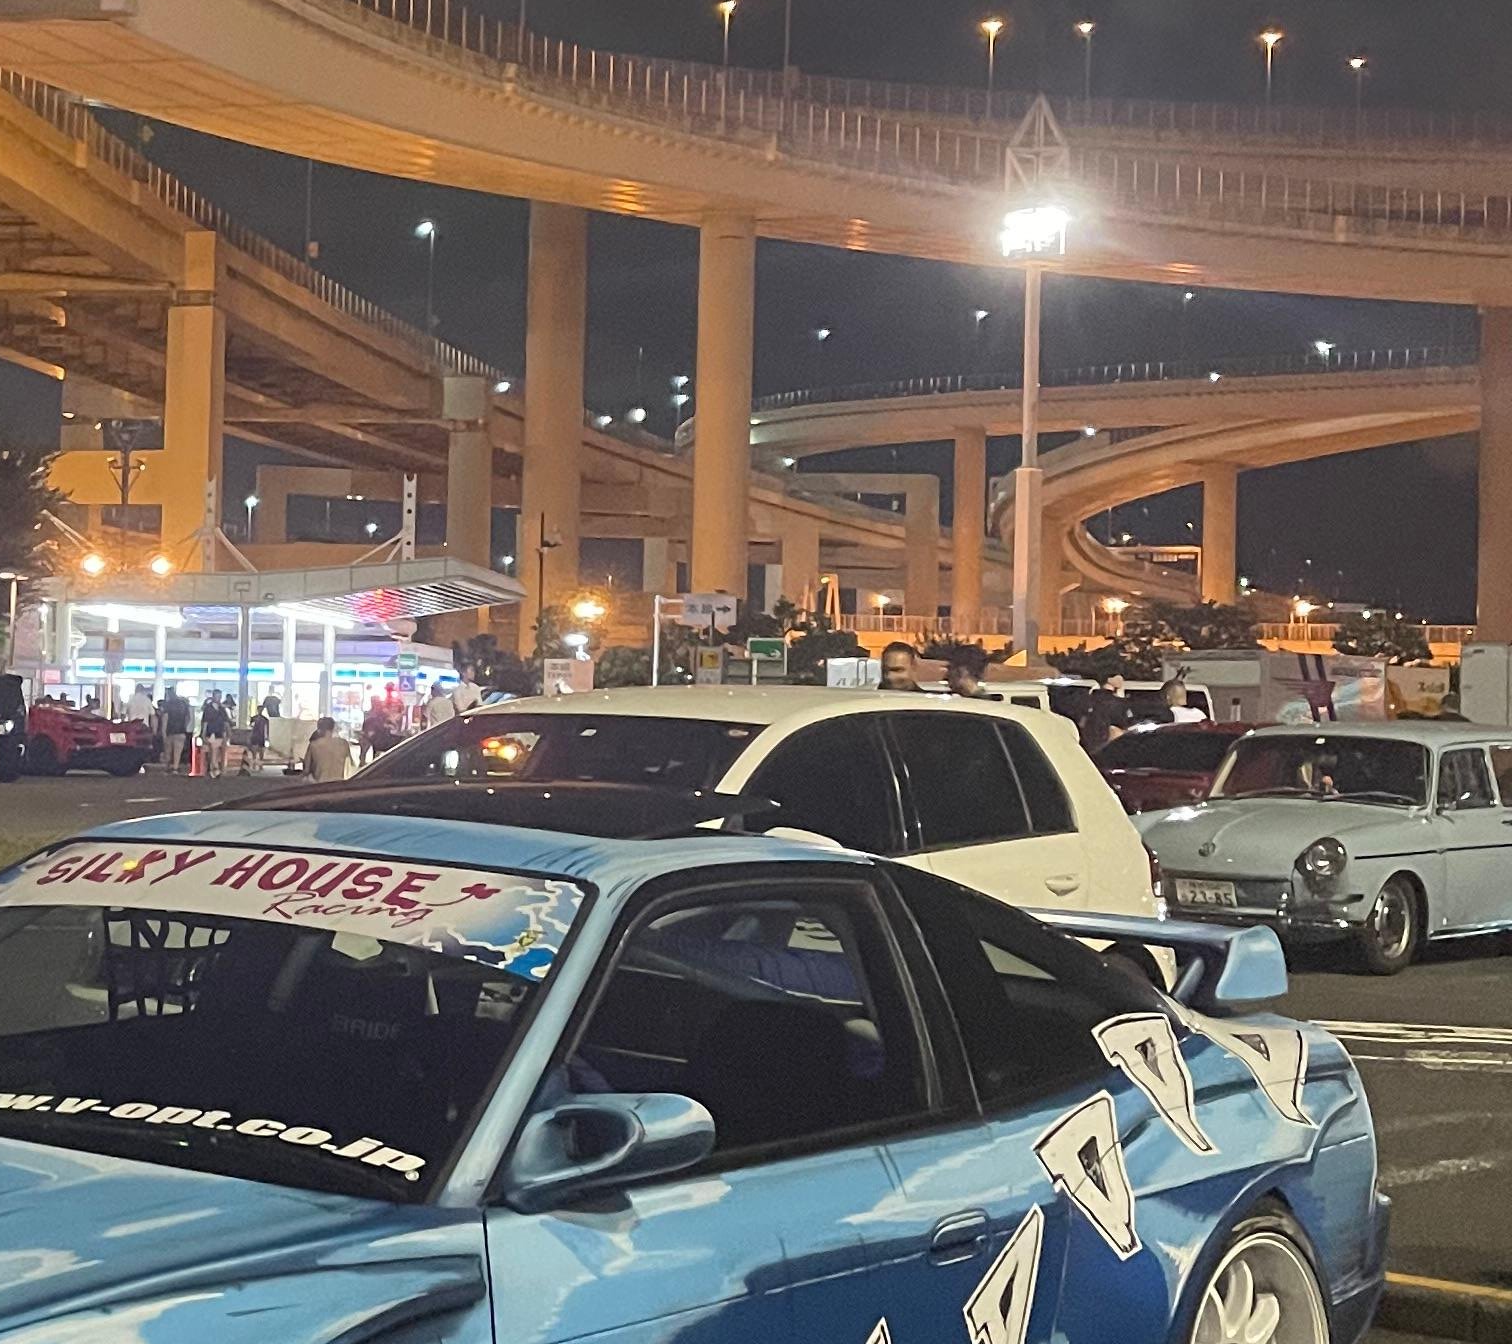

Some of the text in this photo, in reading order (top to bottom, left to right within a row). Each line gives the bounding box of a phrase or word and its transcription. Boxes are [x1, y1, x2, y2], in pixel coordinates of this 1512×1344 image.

[36, 849, 442, 910] SILKY HOUSE
[262, 890, 435, 928] Racing
